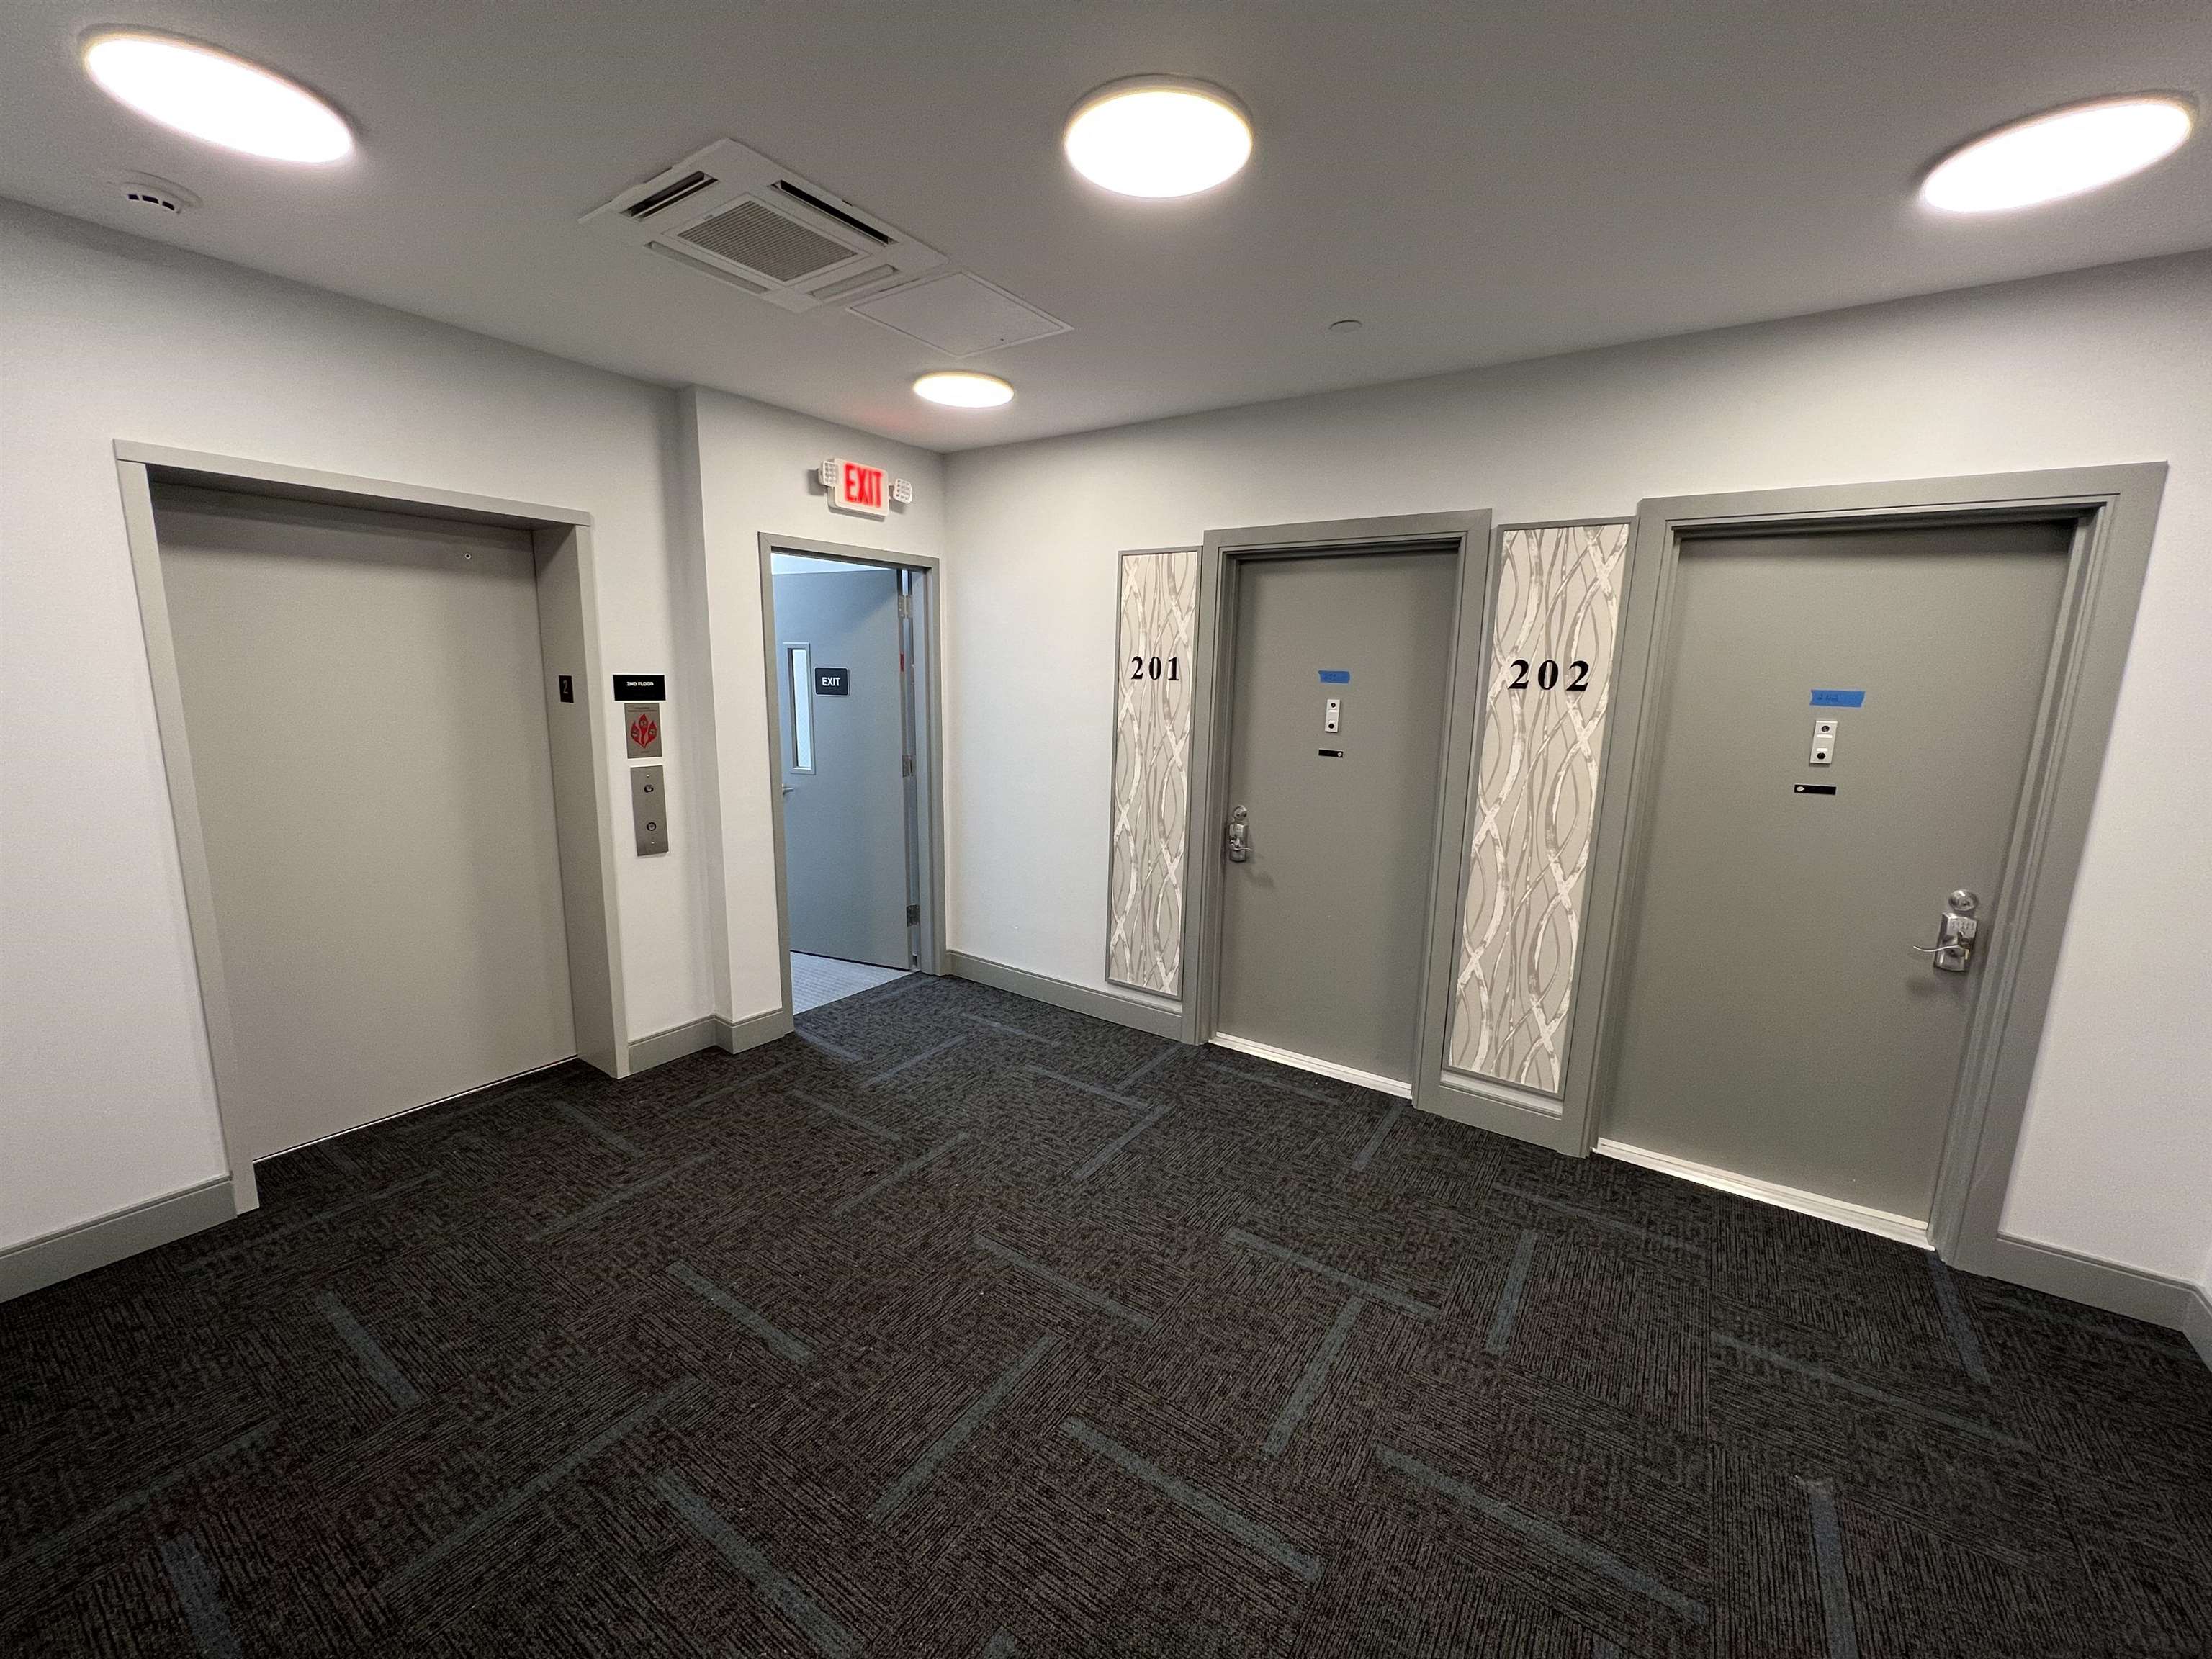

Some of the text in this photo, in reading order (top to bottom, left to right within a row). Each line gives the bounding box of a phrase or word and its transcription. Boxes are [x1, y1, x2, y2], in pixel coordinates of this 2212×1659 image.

[844, 462, 883, 508] EXIT
[1130, 656, 1179, 681] 201
[1507, 659, 1590, 691] 202
[562, 679, 569, 694] 2
[822, 677, 841, 687] EXIT
